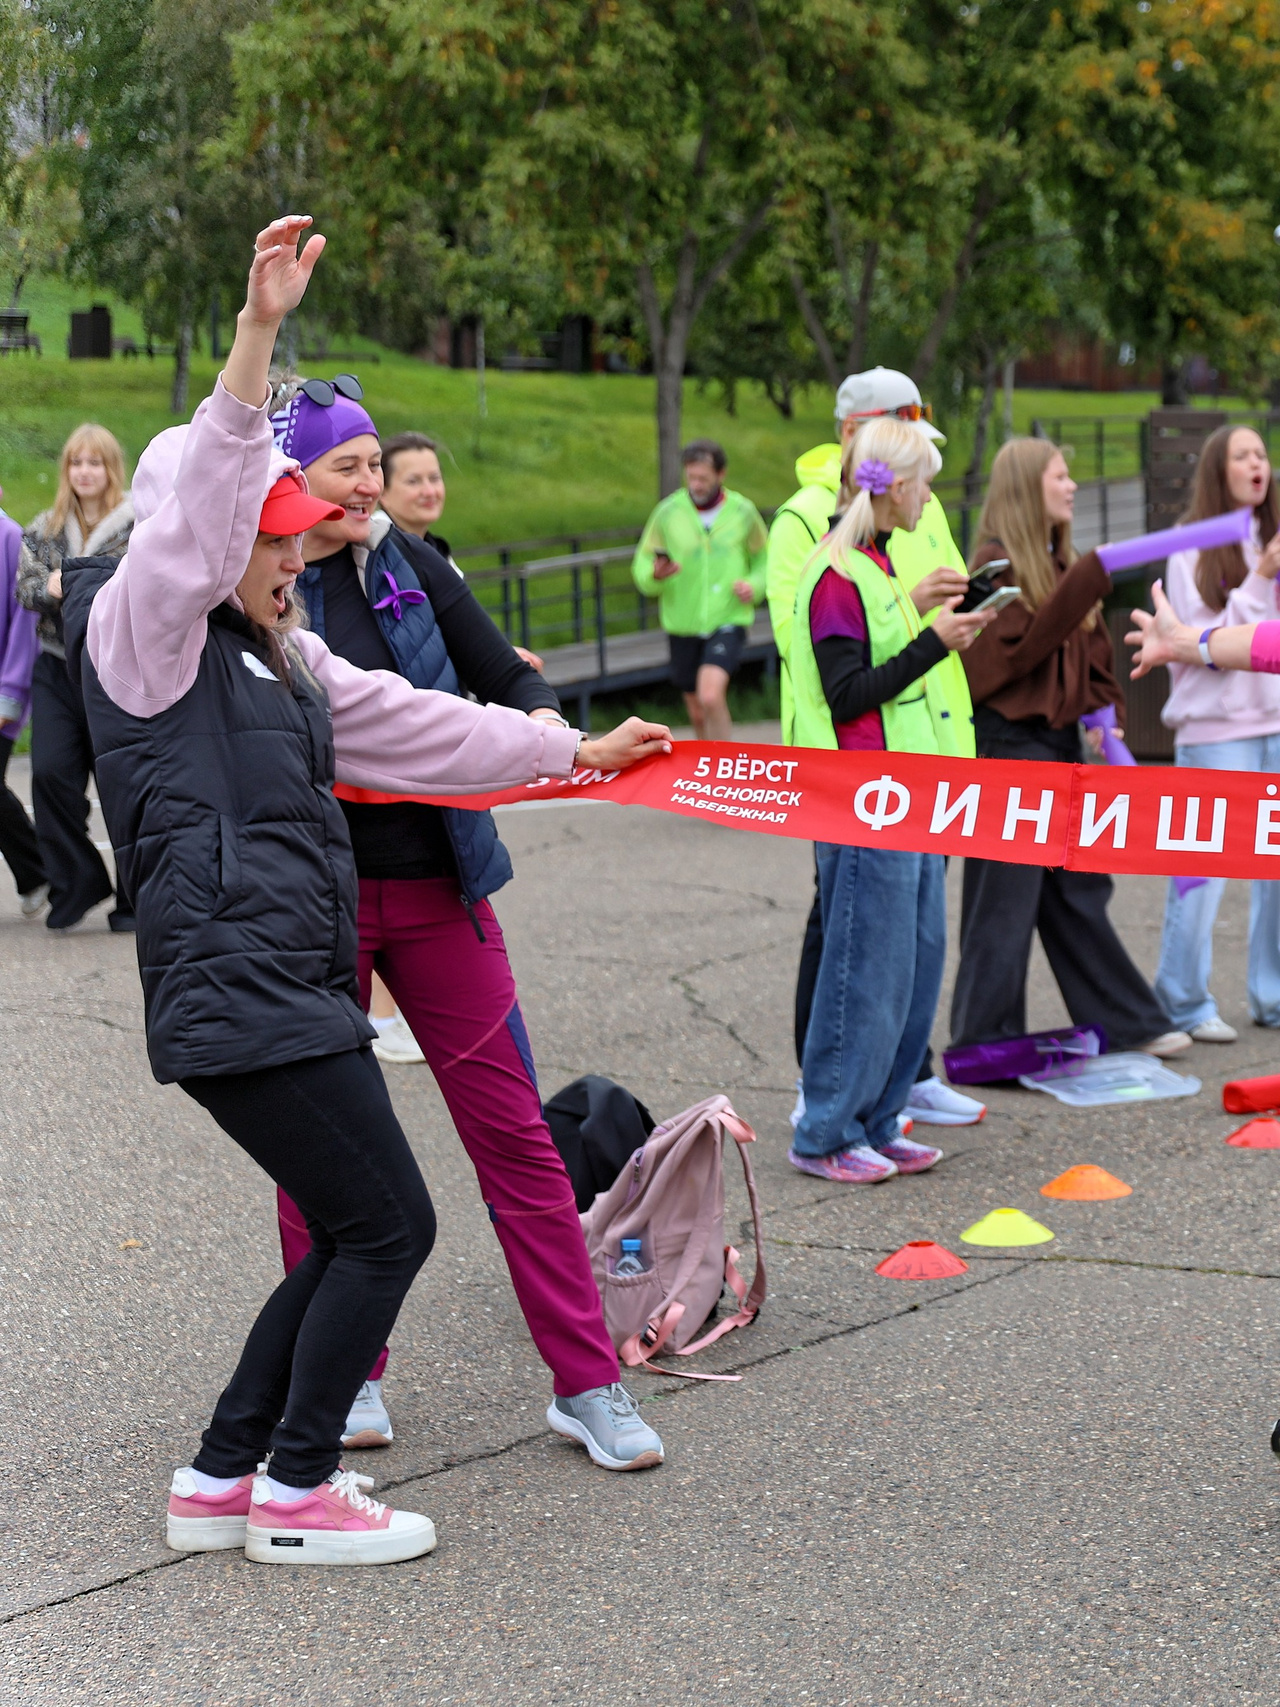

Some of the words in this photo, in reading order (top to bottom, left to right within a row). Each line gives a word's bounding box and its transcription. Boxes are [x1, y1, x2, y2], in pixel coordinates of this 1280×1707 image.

[272, 400, 293, 453] AIL
[285, 399, 301, 456] АРАФОН
[693, 756, 712, 777] 5
[716, 753, 799, 783] ВЁРСТ
[672, 778, 803, 807] КРАСНОЯРСК
[670, 793, 788, 824] НАБЕРЕЖНАЯ
